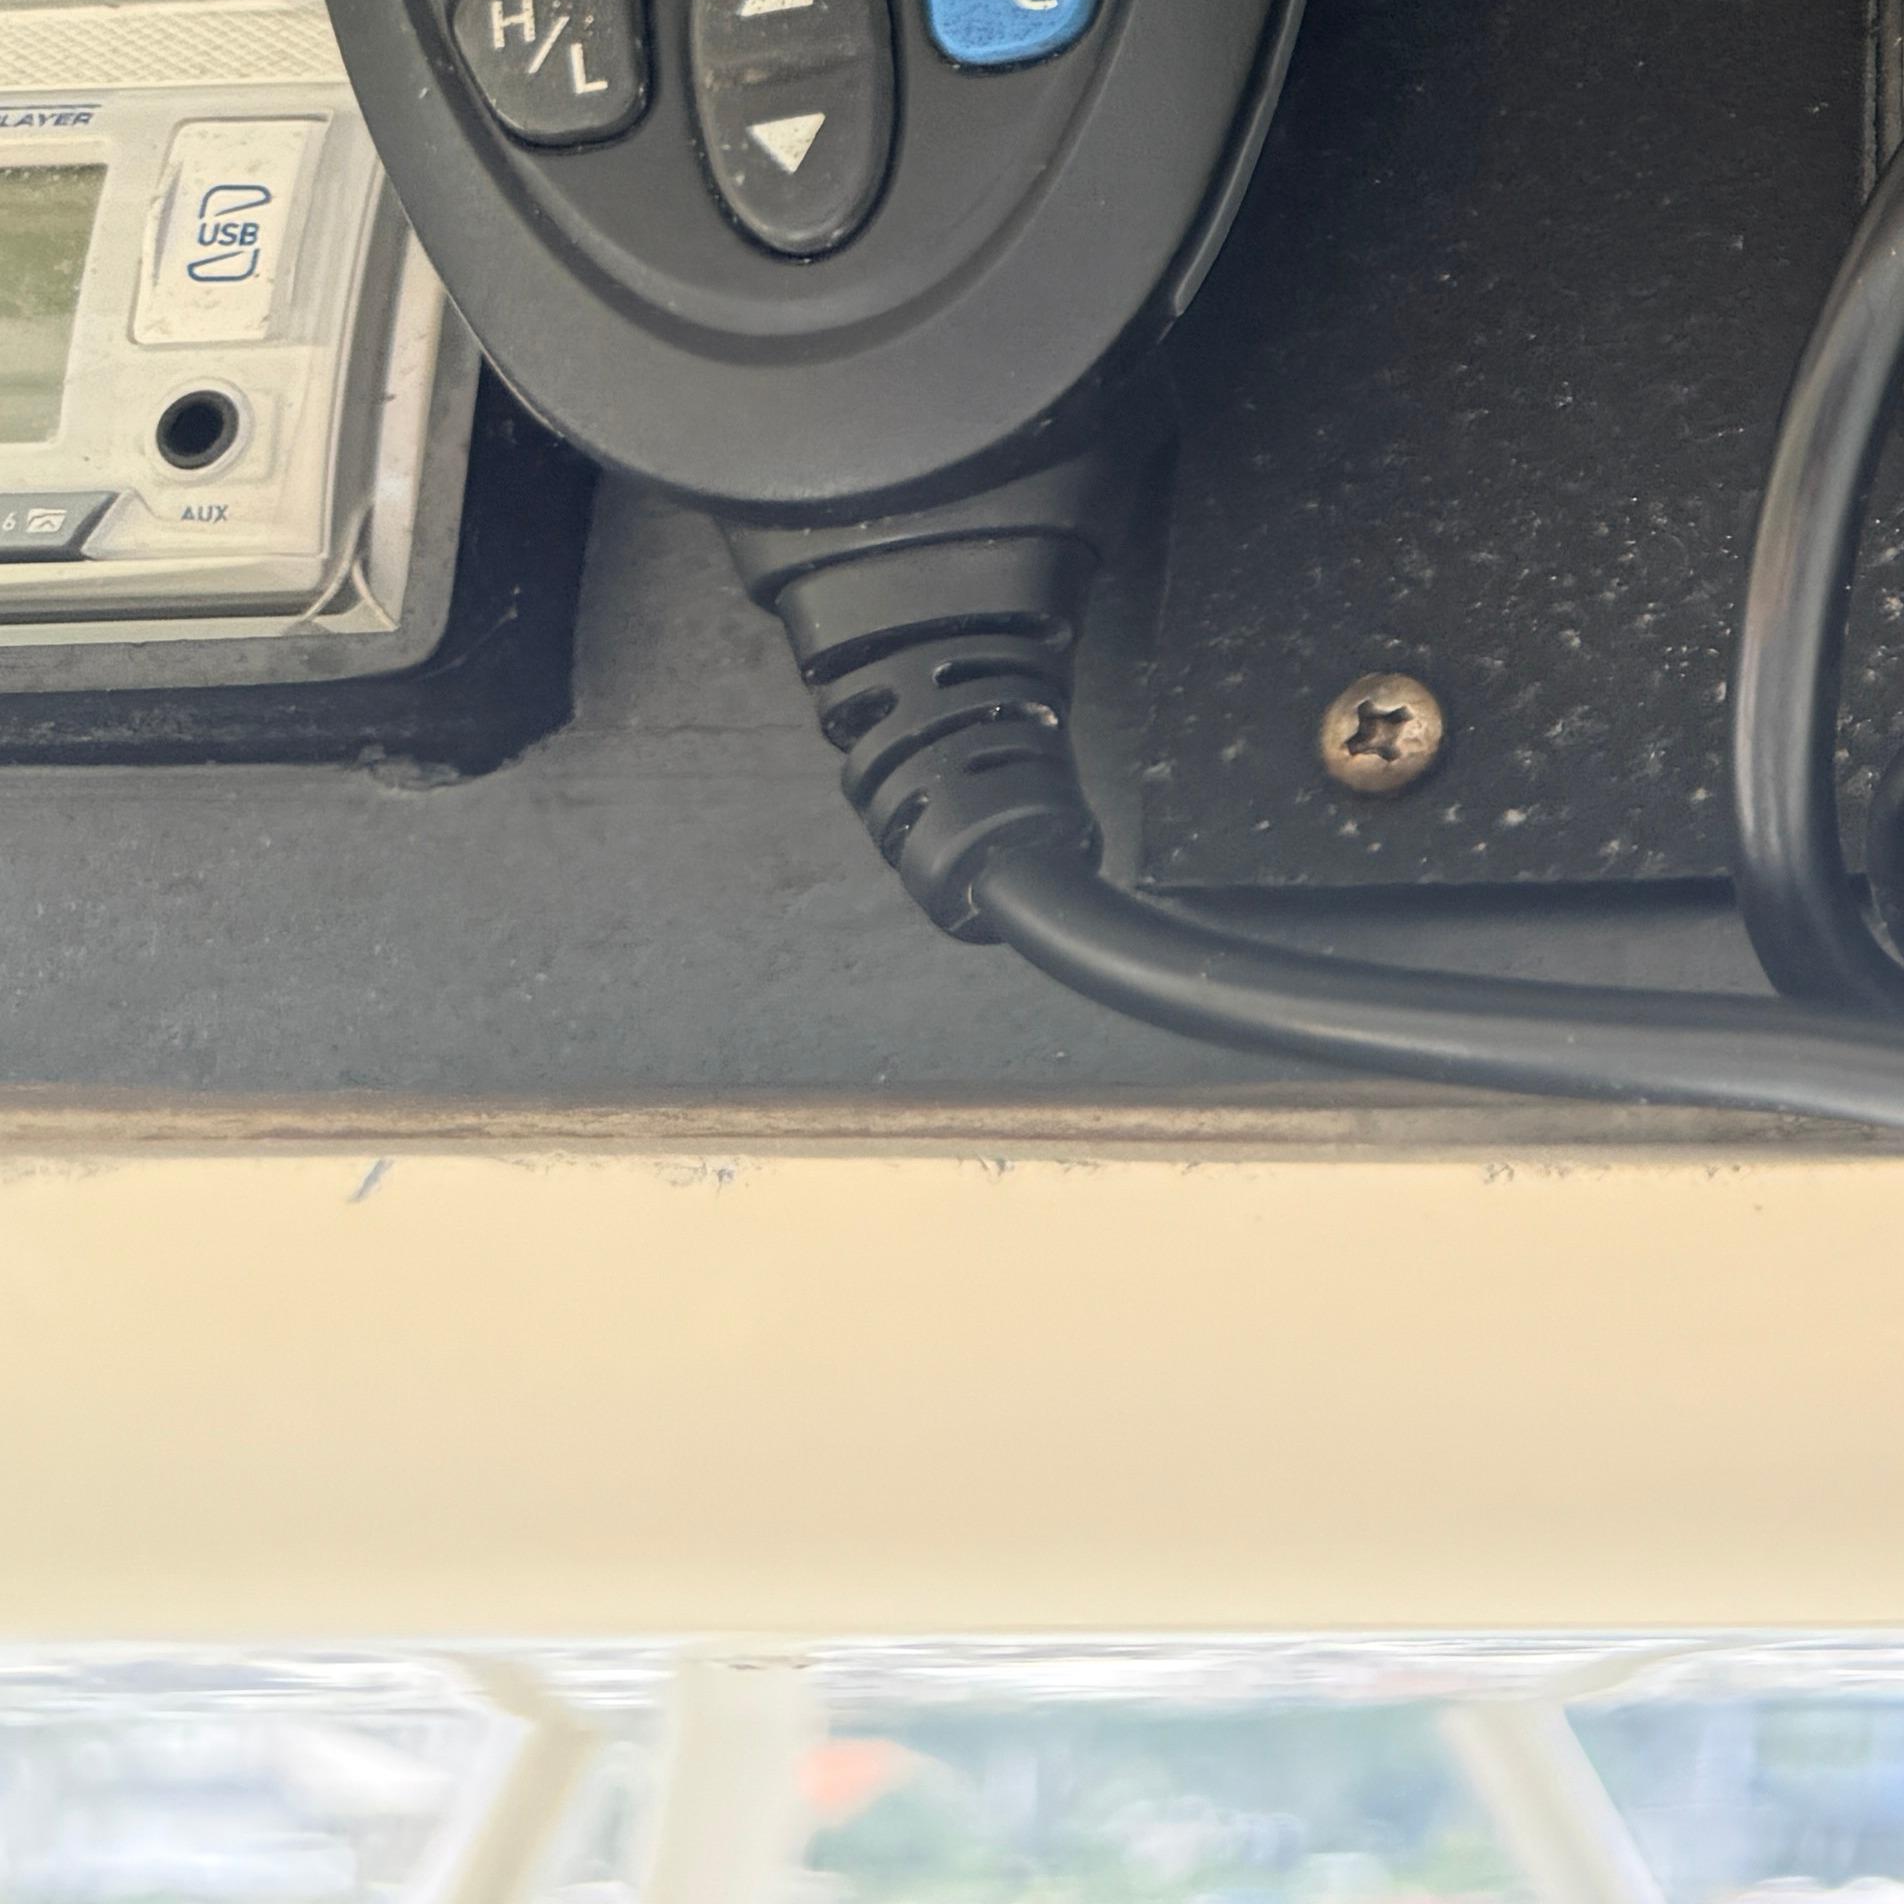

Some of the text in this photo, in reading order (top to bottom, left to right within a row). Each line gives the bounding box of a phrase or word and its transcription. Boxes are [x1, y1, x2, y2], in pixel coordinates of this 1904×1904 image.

[199, 222, 258, 246] USB
[2, 512, 16, 532] 6
[180, 505, 229, 523] AUX
